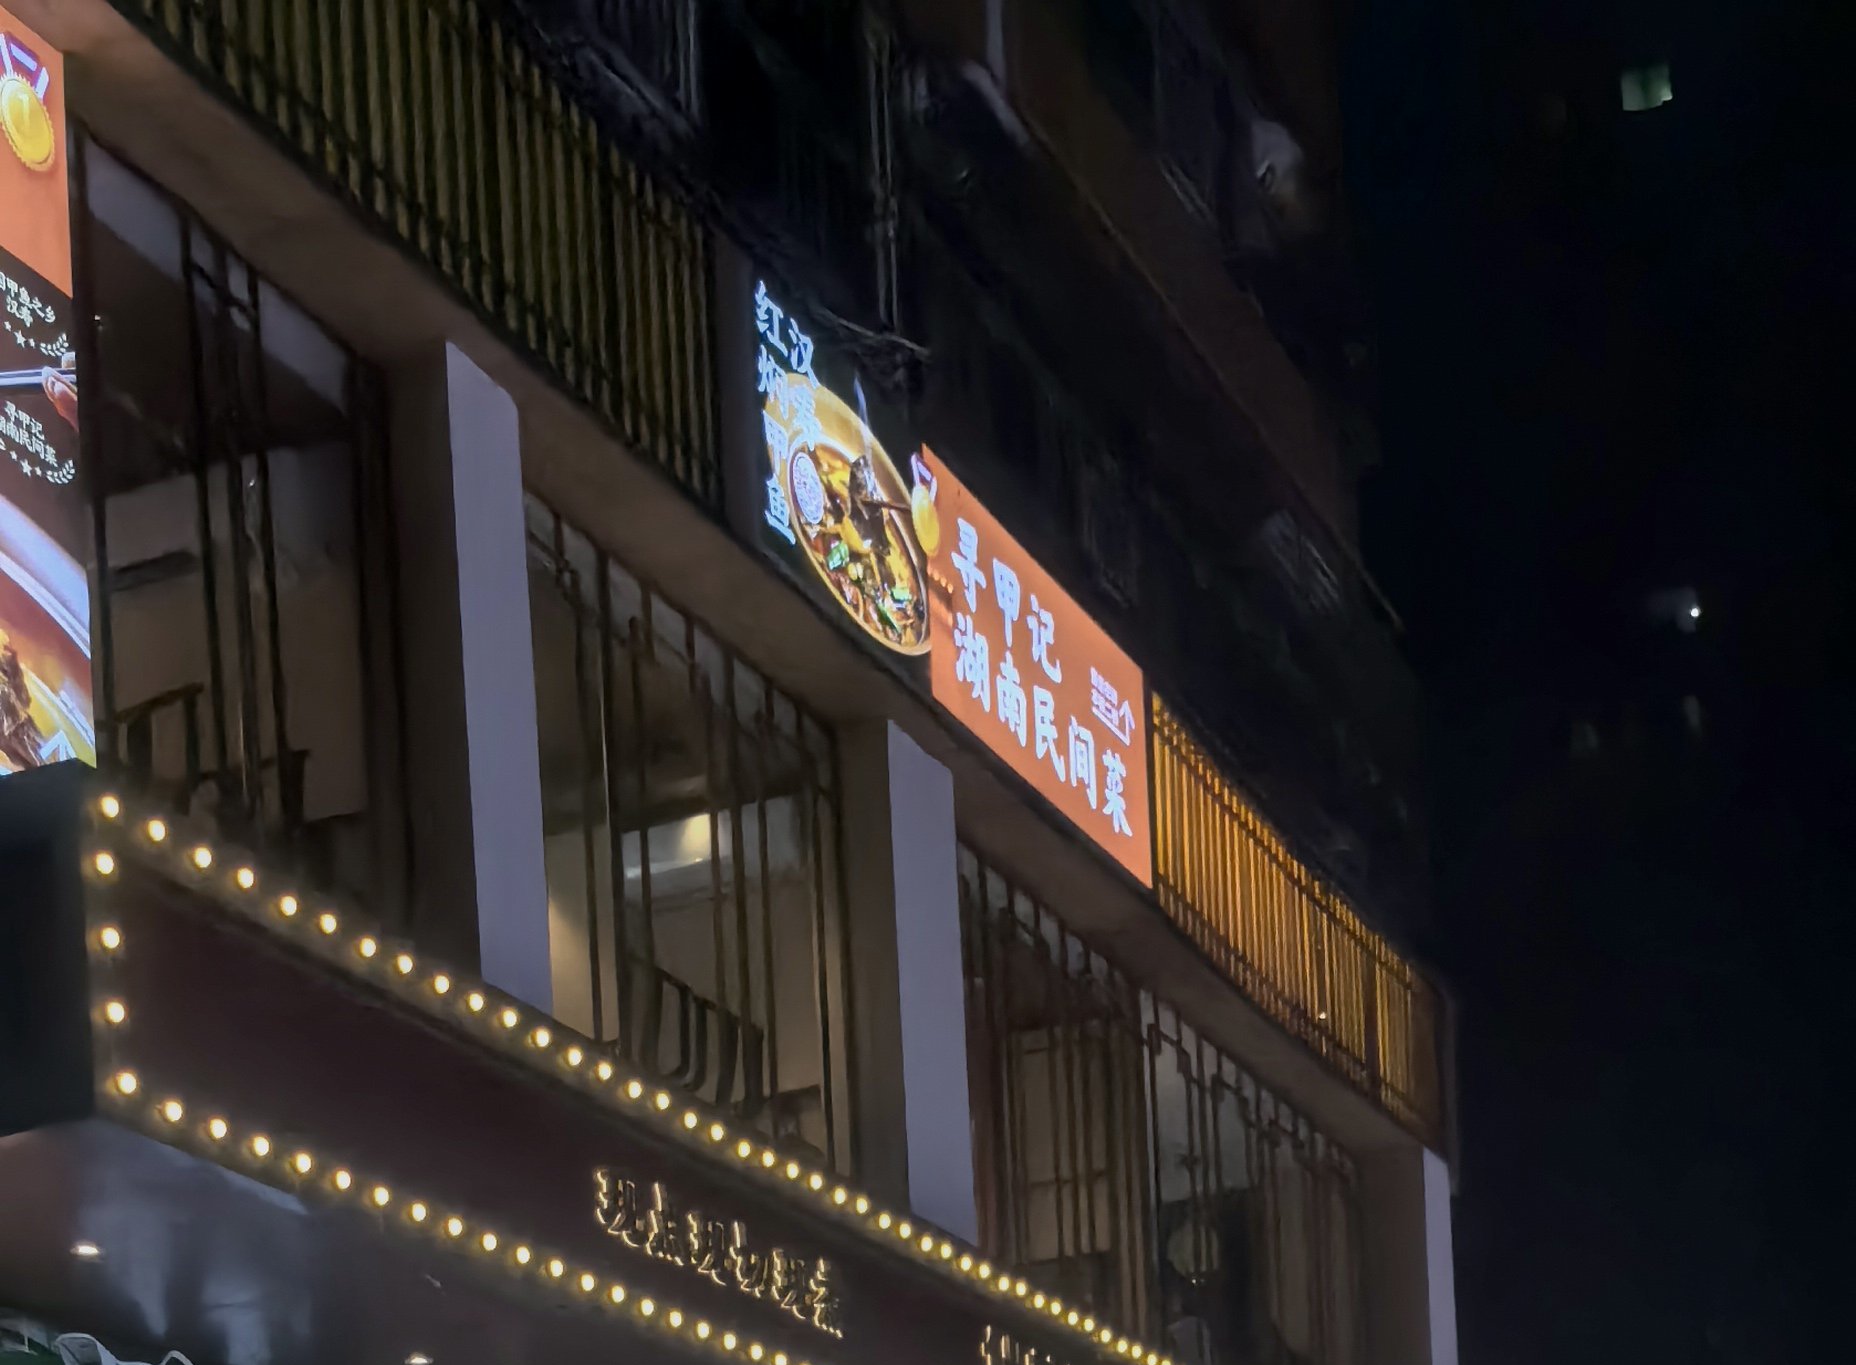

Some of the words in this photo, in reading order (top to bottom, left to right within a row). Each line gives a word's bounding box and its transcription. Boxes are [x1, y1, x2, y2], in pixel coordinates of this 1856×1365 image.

[951, 518, 1063, 684] 寻甲记
[953, 611, 1133, 837] 湖南民间菜
